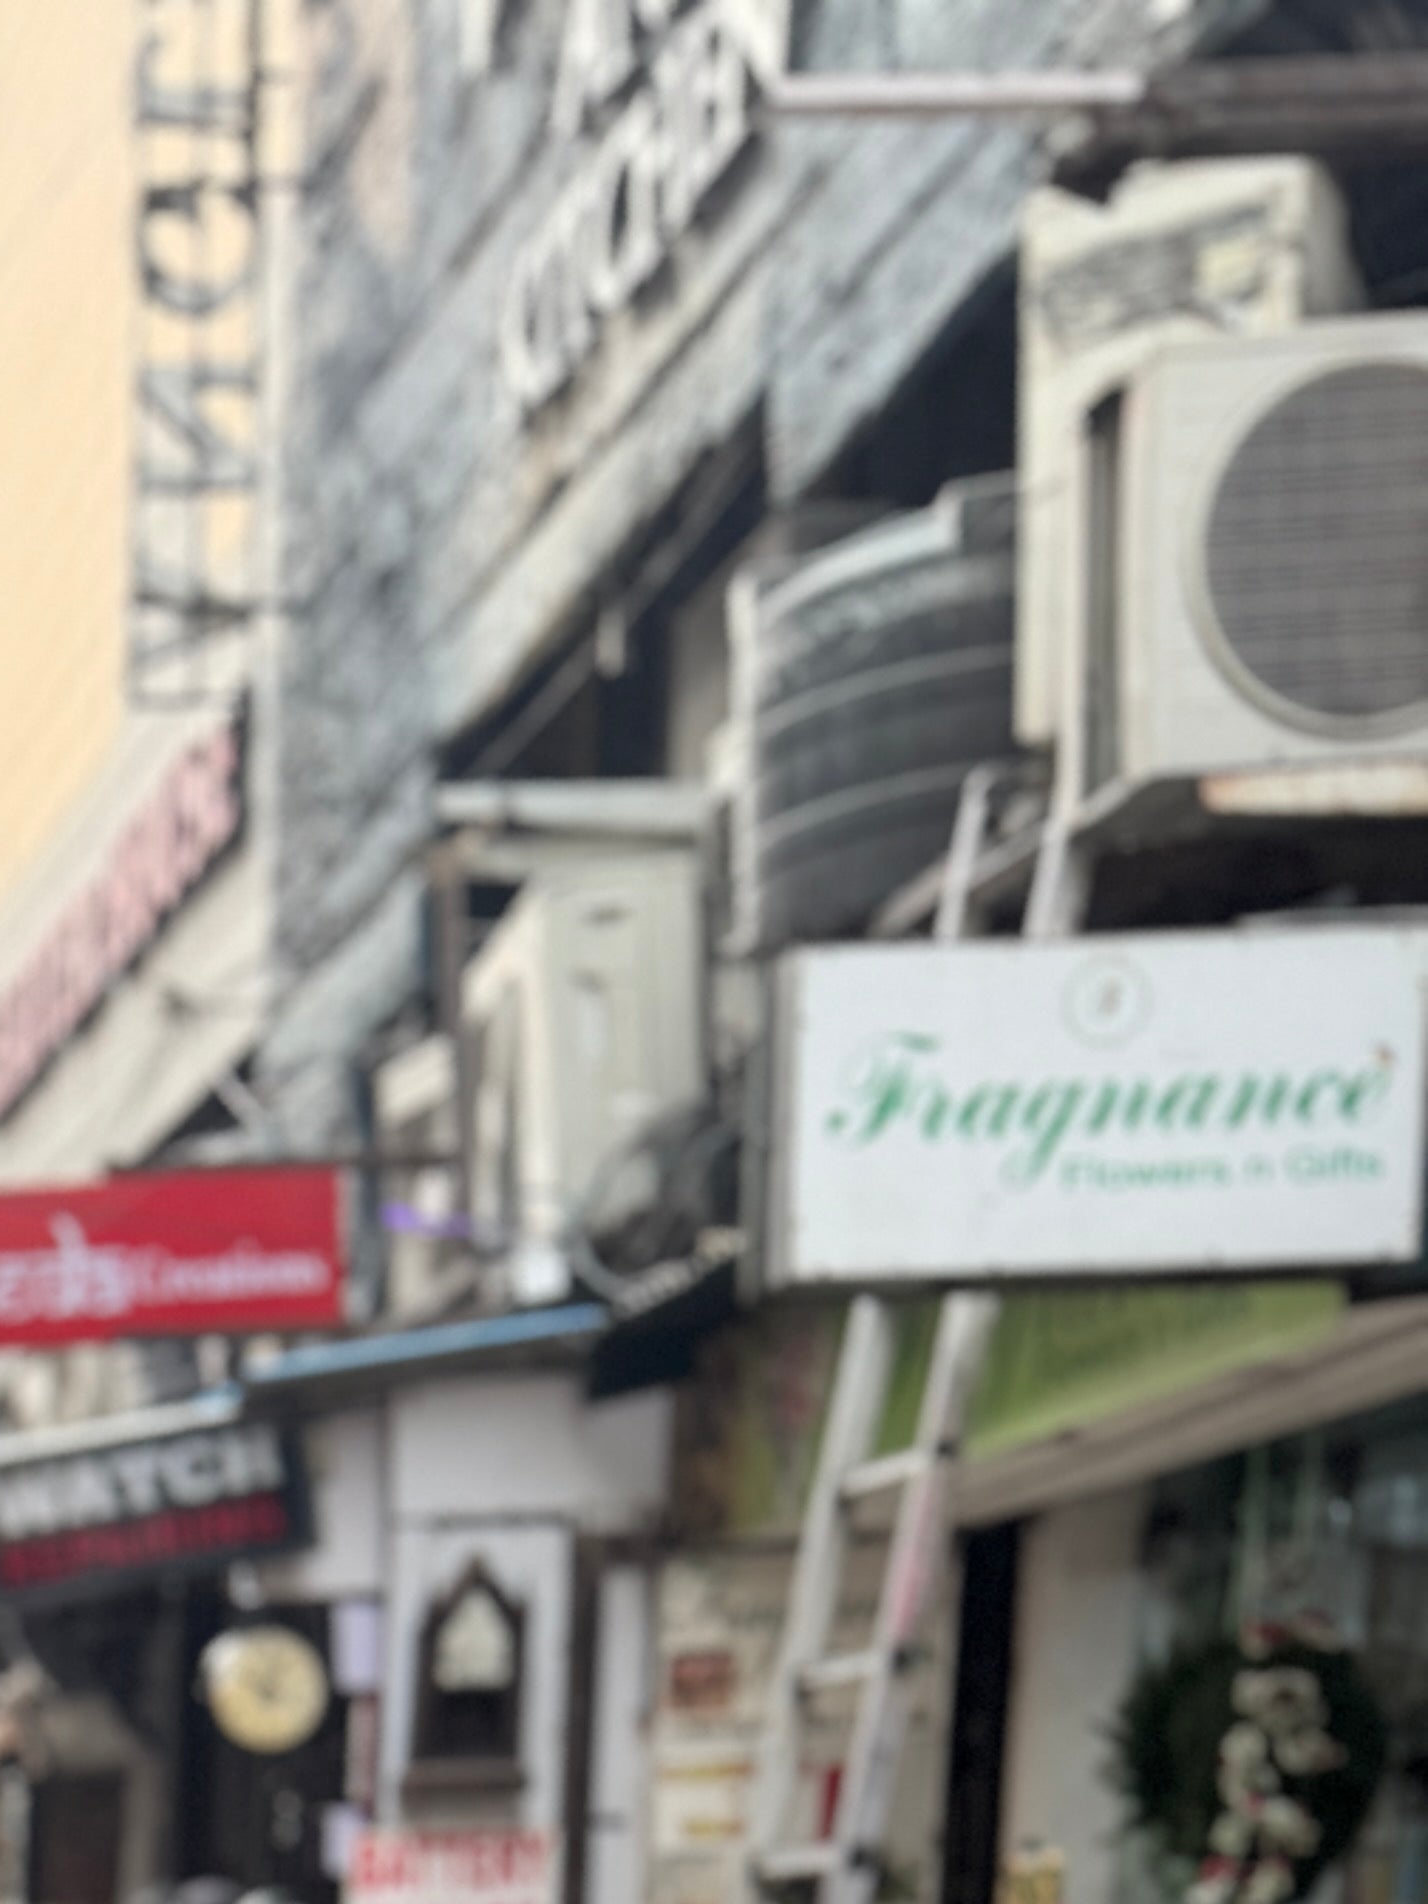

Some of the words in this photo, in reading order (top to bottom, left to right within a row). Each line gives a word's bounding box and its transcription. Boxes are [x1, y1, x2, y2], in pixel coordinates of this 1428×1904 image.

[825, 1030, 1392, 1189] Fragnance
[1060, 1153, 1231, 1191] Flowers
[355, 1831, 546, 1890] BATTERY
